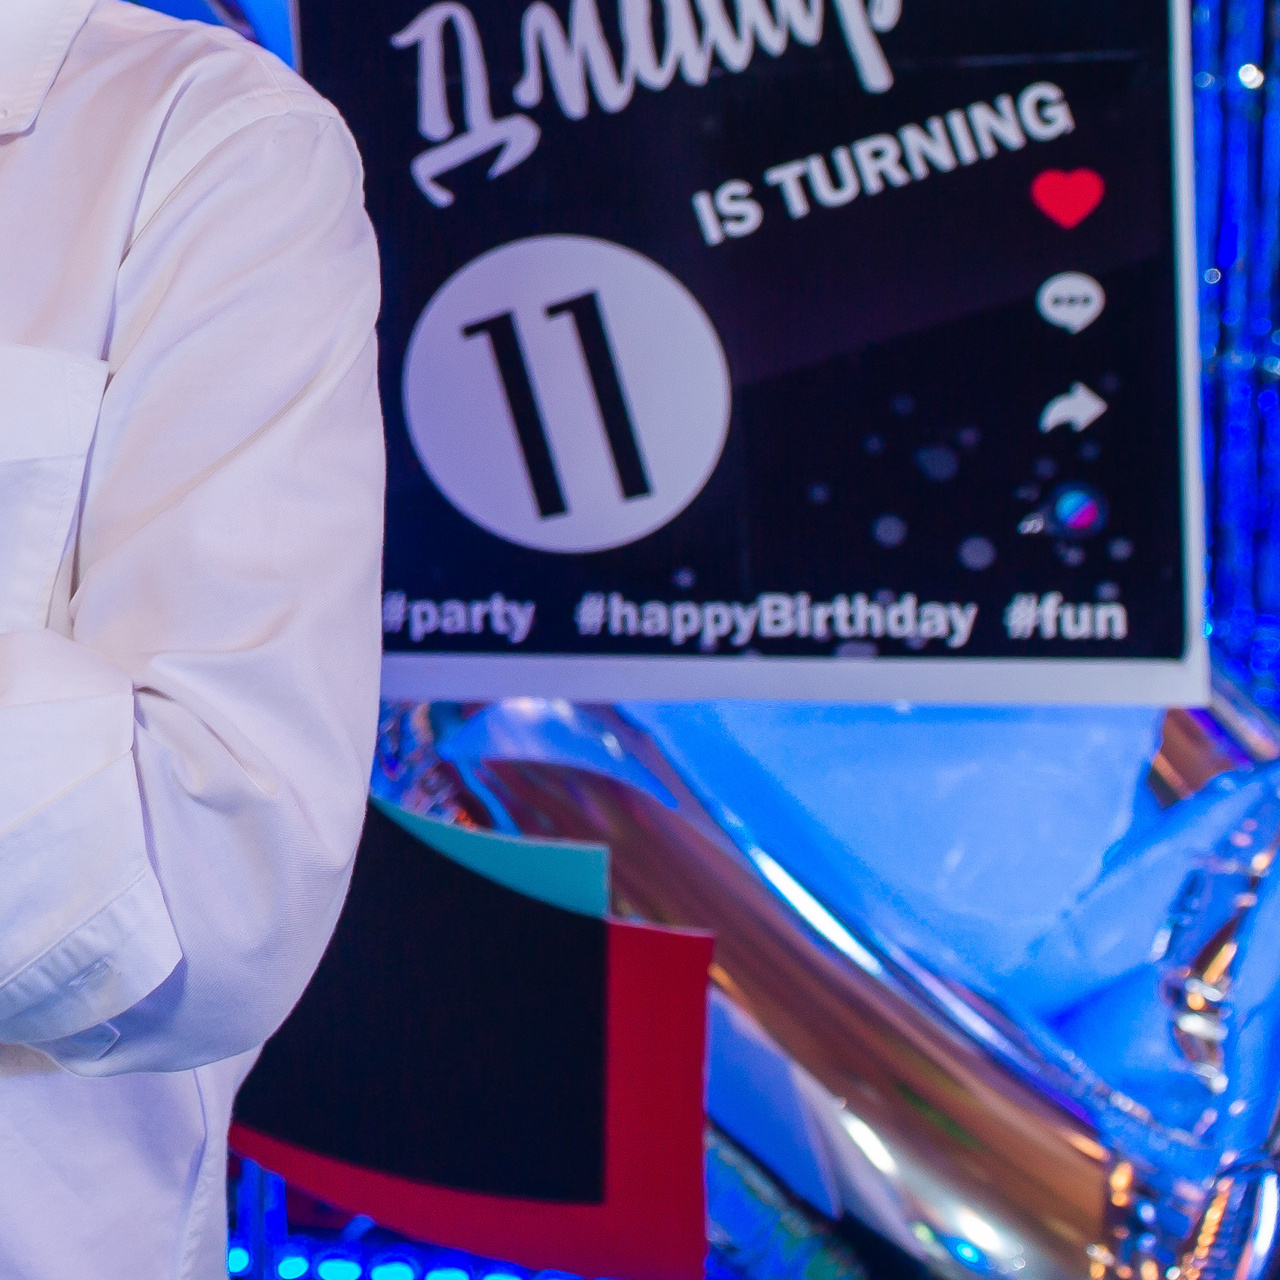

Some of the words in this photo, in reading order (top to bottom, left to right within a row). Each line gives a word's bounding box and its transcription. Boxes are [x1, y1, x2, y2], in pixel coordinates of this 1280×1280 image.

[692, 182, 764, 246] IS
[765, 82, 1074, 217] TURNING
[461, 289, 653, 521] 11
[382, 590, 535, 643] #party
[574, 592, 976, 646] #happyBirthday
[1003, 592, 1128, 641] #fun
